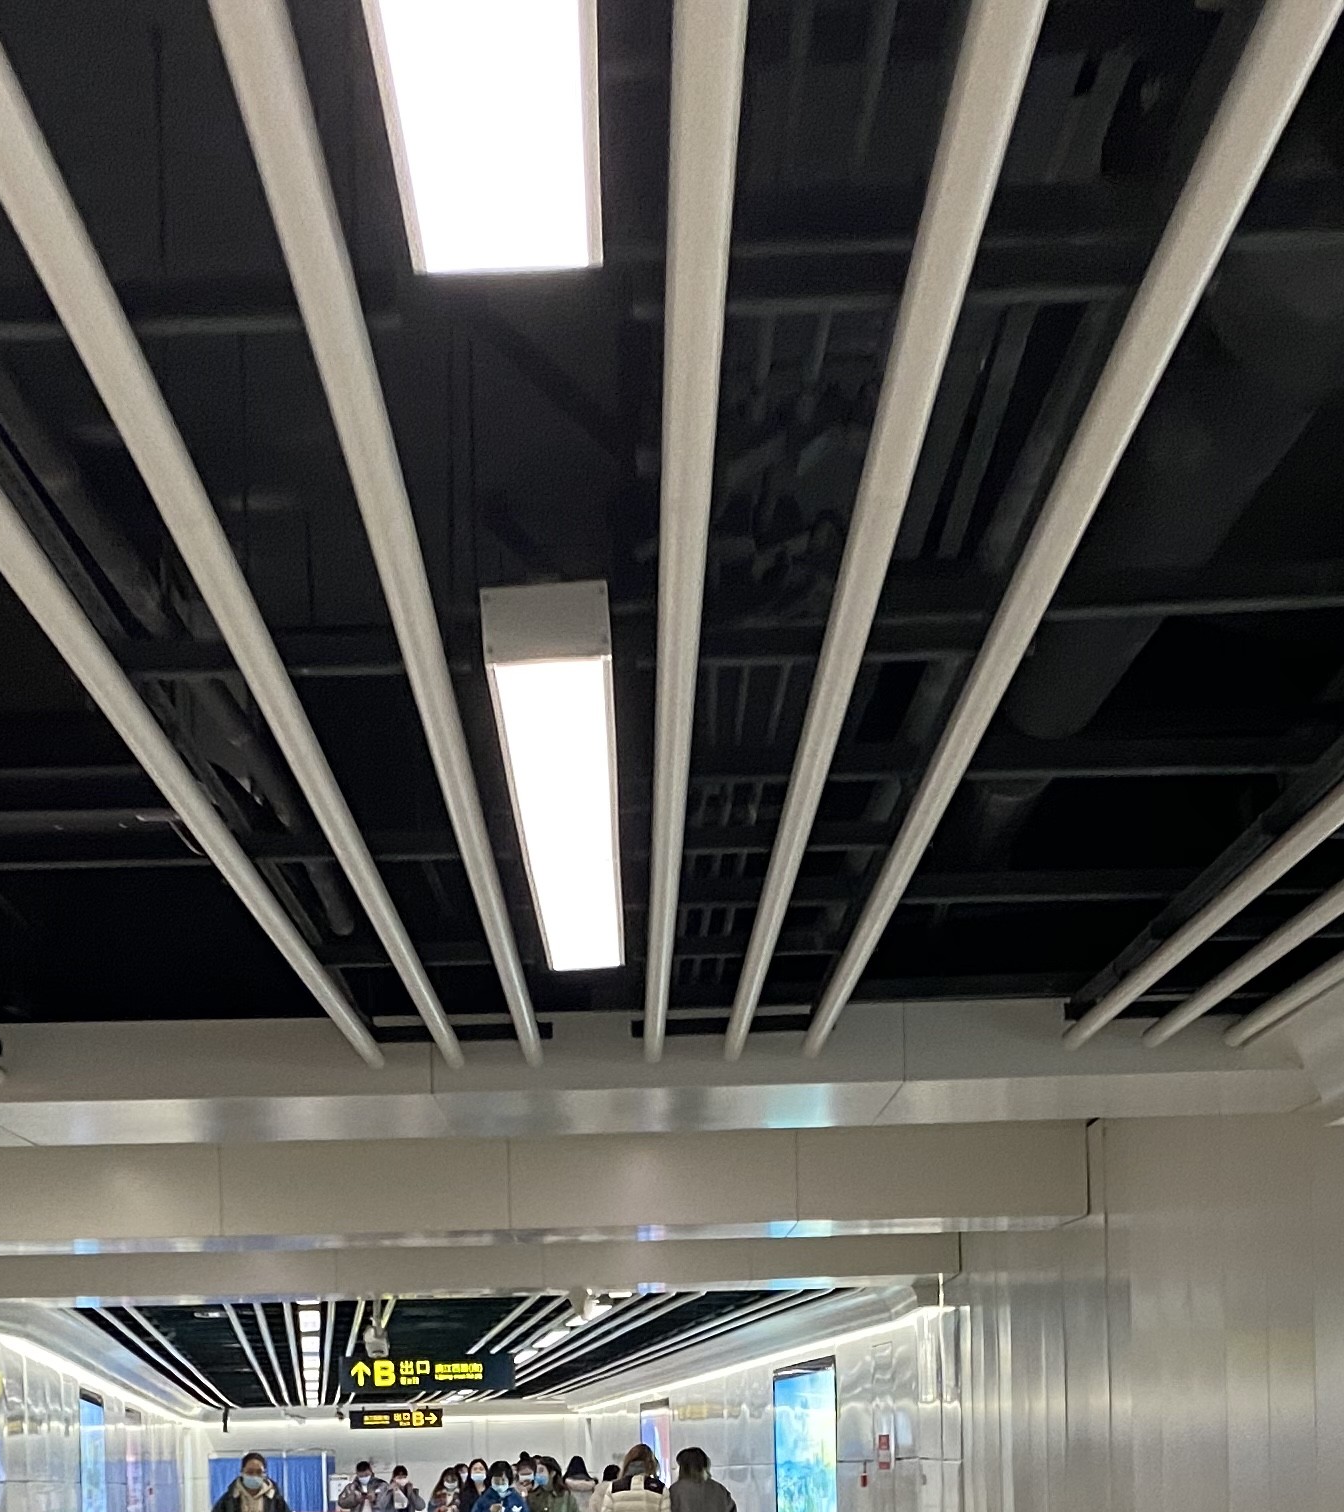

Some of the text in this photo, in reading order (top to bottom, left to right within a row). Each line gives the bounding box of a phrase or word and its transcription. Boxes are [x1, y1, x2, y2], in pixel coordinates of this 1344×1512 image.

[373, 1359, 396, 1387] B
[400, 1360, 431, 1375] 出口
[412, 1411, 425, 1427] B
